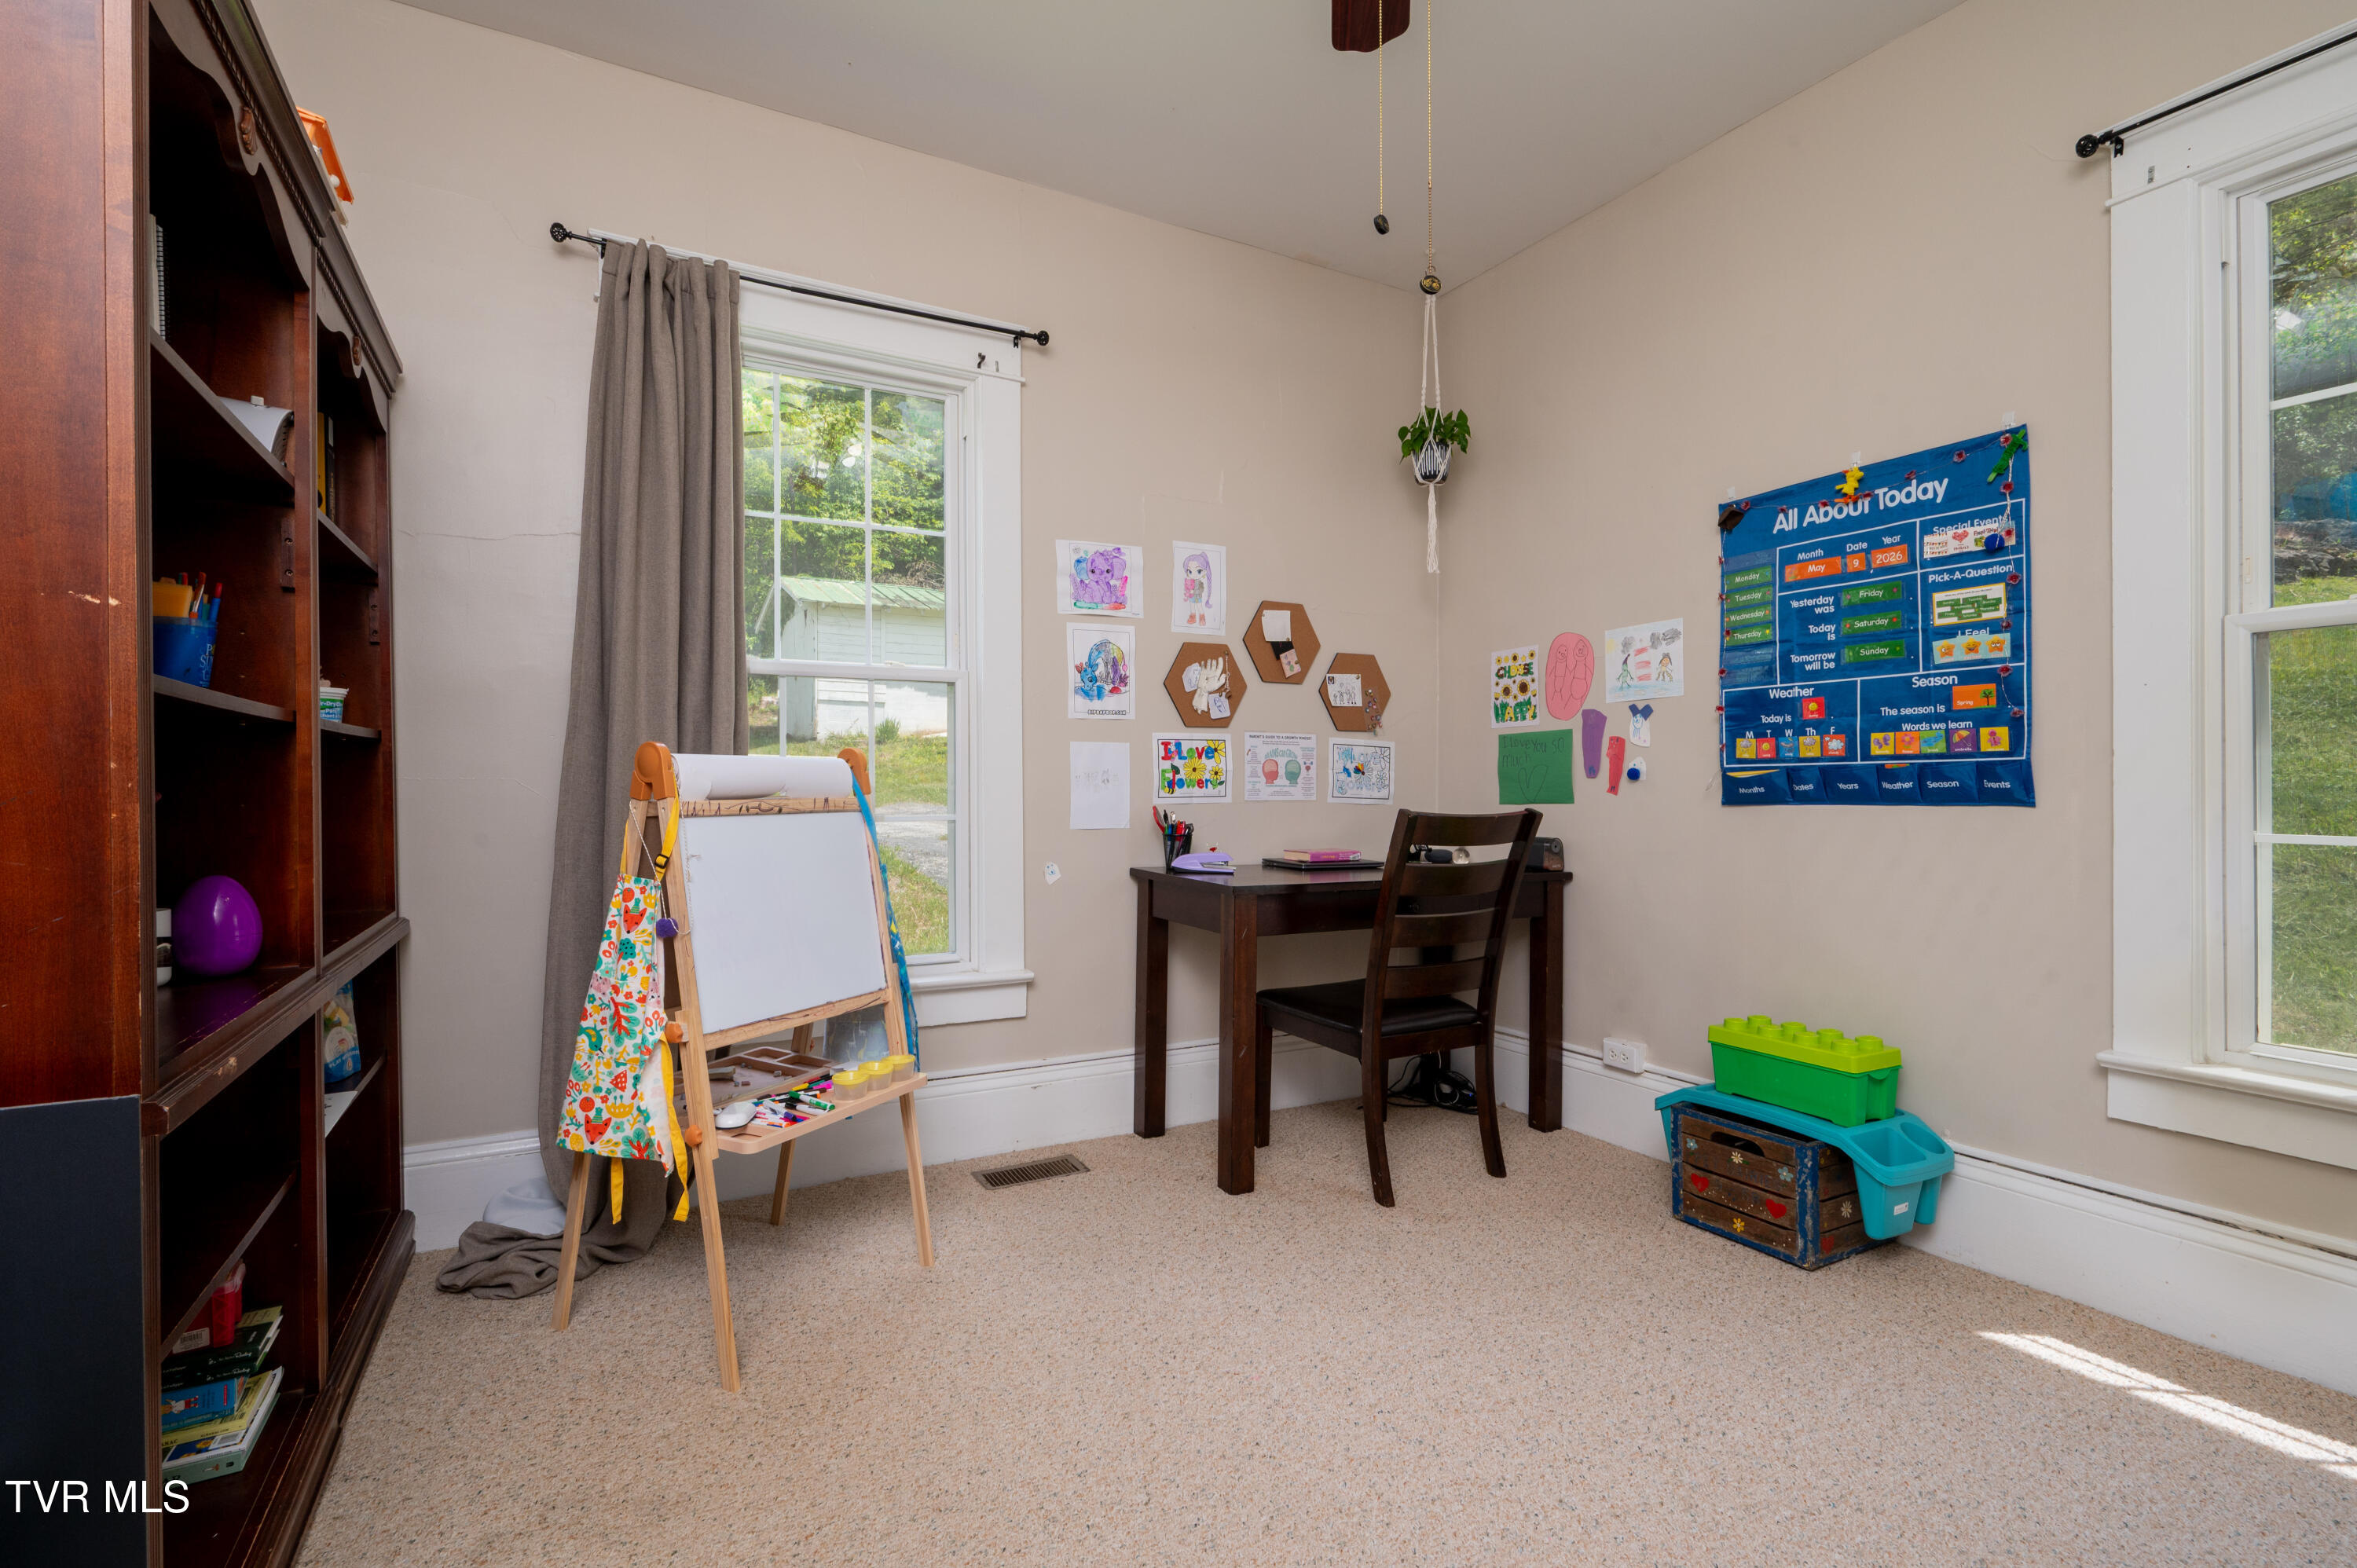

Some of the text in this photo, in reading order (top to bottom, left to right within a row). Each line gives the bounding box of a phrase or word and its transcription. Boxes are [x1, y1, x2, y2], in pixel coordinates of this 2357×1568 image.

[1772, 478, 1948, 534] All About Today
[1933, 520, 1970, 534] Special
[1882, 535, 1901, 545] Year
[1846, 541, 1868, 552] Date
[1797, 548, 1824, 561] Month
[1876, 551, 1903, 565] 2026
[1808, 564, 1826, 573] May
[1853, 559, 1859, 568] 9
[1735, 573, 1760, 584] Monday
[1929, 565, 2013, 583] Pick-A-Question
[1735, 592, 1761, 603] Tuesday
[1859, 589, 1884, 599] Friday
[1790, 595, 1835, 609] Yesterday
[1814, 605, 1835, 614] was
[1729, 610, 1765, 622] Wednesday
[1854, 617, 1889, 629] Saturday
[1808, 624, 1835, 635] Today
[1733, 631, 1761, 640] Thursday
[1860, 647, 1889, 658] Sunday
[1790, 652, 1836, 665] Tomorrow
[1495, 662, 1534, 680] CHOOSE
[1805, 661, 1835, 672] will be
[1912, 675, 1958, 688] Season
[1769, 687, 1815, 699] Weather
[1494, 698, 1538, 724] HAPPY
[1880, 704, 1945, 716] The season is
[1761, 713, 1792, 724] Today is
[1831, 726, 1835, 735] F
[1902, 721, 1930, 731] Words
[1948, 720, 1973, 729] learn
[1805, 727, 1816, 736] Th
[1160, 742, 1215, 760] I Love
[1882, 781, 1913, 789] Weather
[1983, 779, 2011, 789] Events
